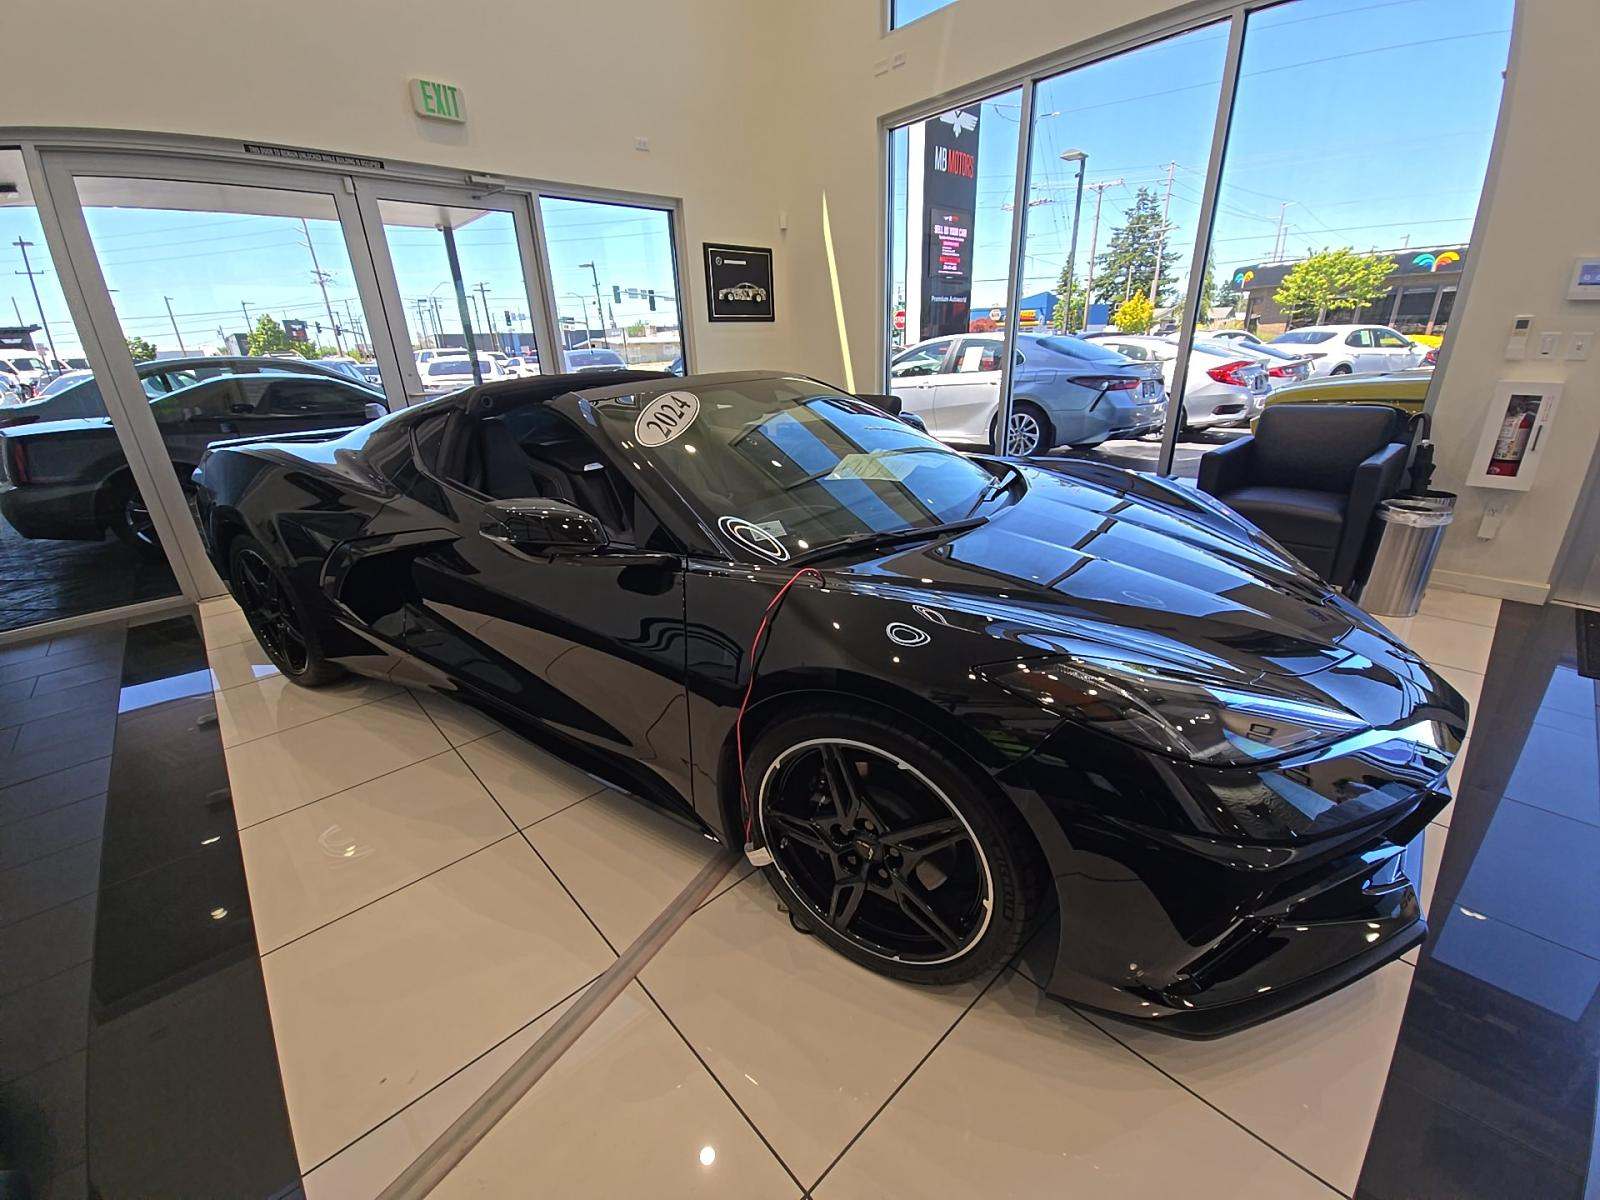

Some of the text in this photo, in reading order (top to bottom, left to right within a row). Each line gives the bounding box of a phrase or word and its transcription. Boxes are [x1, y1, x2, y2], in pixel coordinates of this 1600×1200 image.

[419, 79, 460, 119] EXIT
[934, 145, 974, 178] MB MOTORS
[646, 395, 691, 439] 2024
